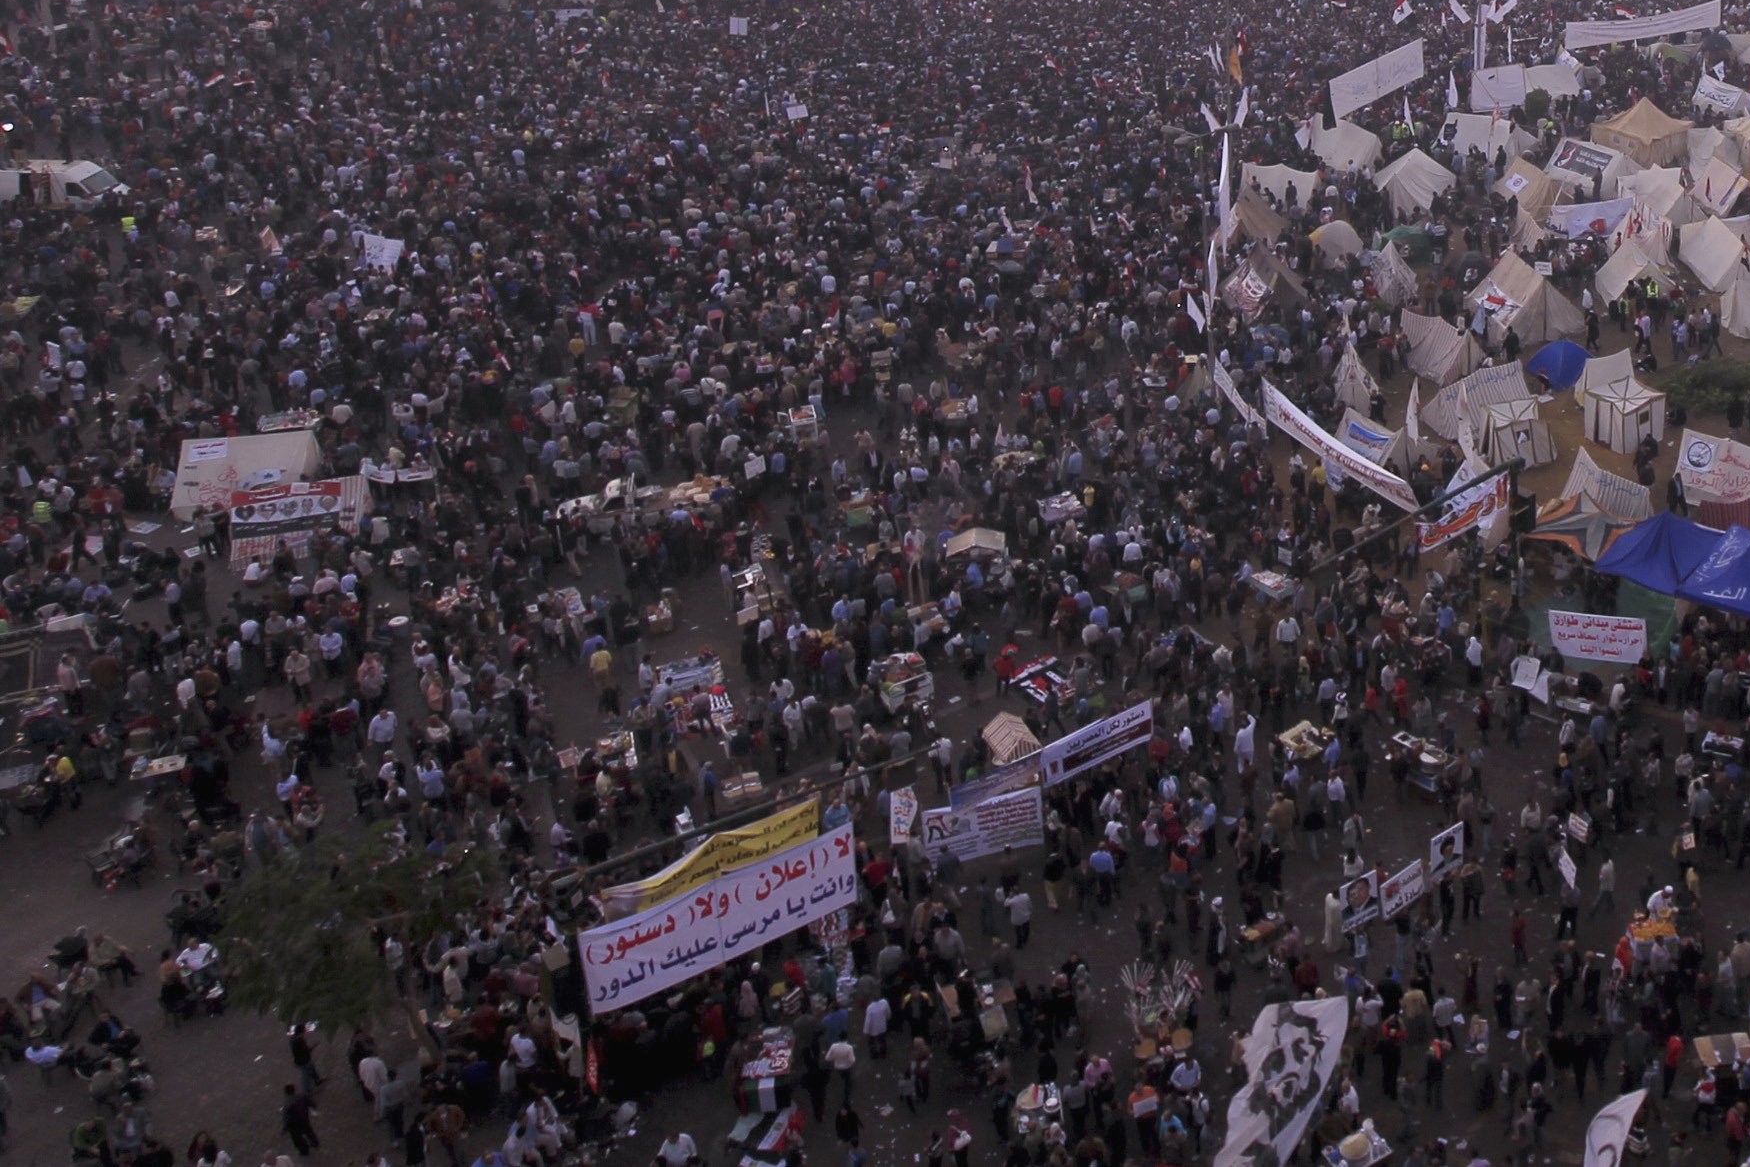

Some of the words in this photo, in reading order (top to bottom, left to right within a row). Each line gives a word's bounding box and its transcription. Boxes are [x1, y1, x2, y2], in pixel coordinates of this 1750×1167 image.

[1106, 719, 1122, 735] لكل
[1121, 710, 1145, 728] دستور
[1066, 727, 1105, 754] المصريين
[834, 832, 852, 858] لا
[787, 897, 806, 918] يا
[660, 934, 718, 970] عليك
[594, 958, 656, 1002] الدور
